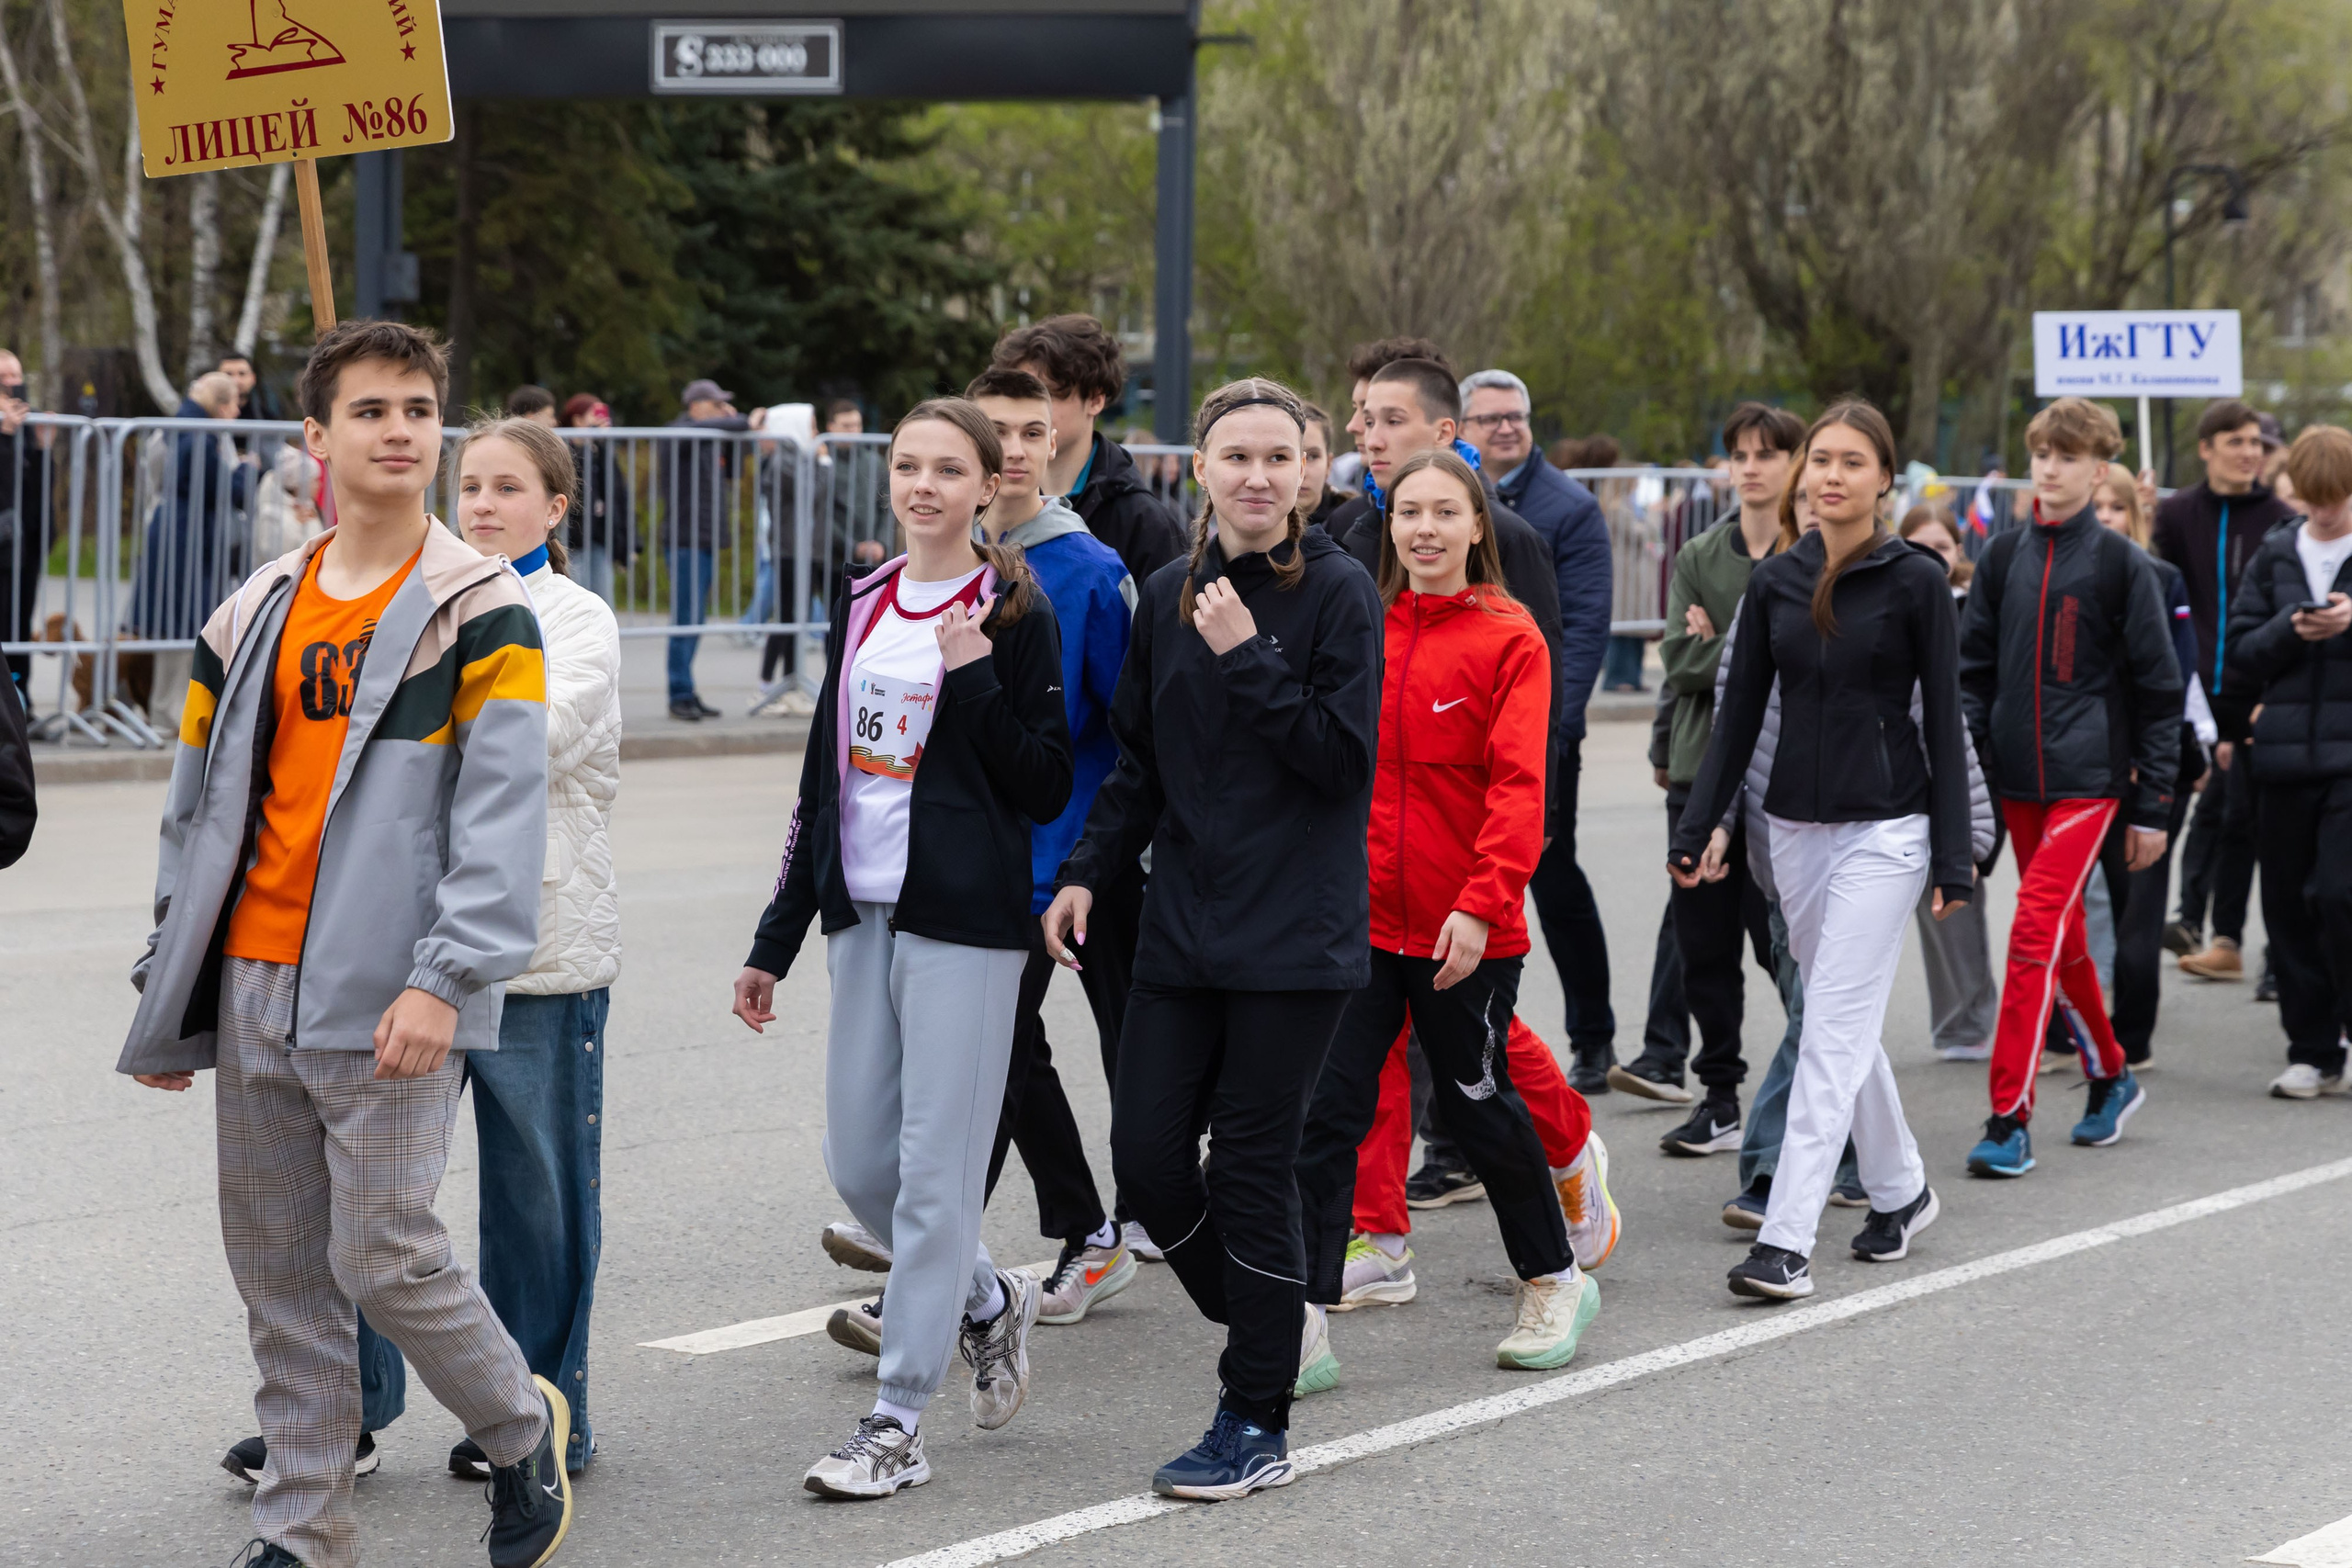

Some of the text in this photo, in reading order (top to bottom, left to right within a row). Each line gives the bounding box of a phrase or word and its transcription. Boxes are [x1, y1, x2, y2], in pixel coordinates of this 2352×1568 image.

[164, 93, 428, 164] ЛИЦЕЙ №86
[2058, 321, 2218, 359] ИжГТУ
[856, 706, 884, 741] 86
[897, 715, 907, 735] 4
